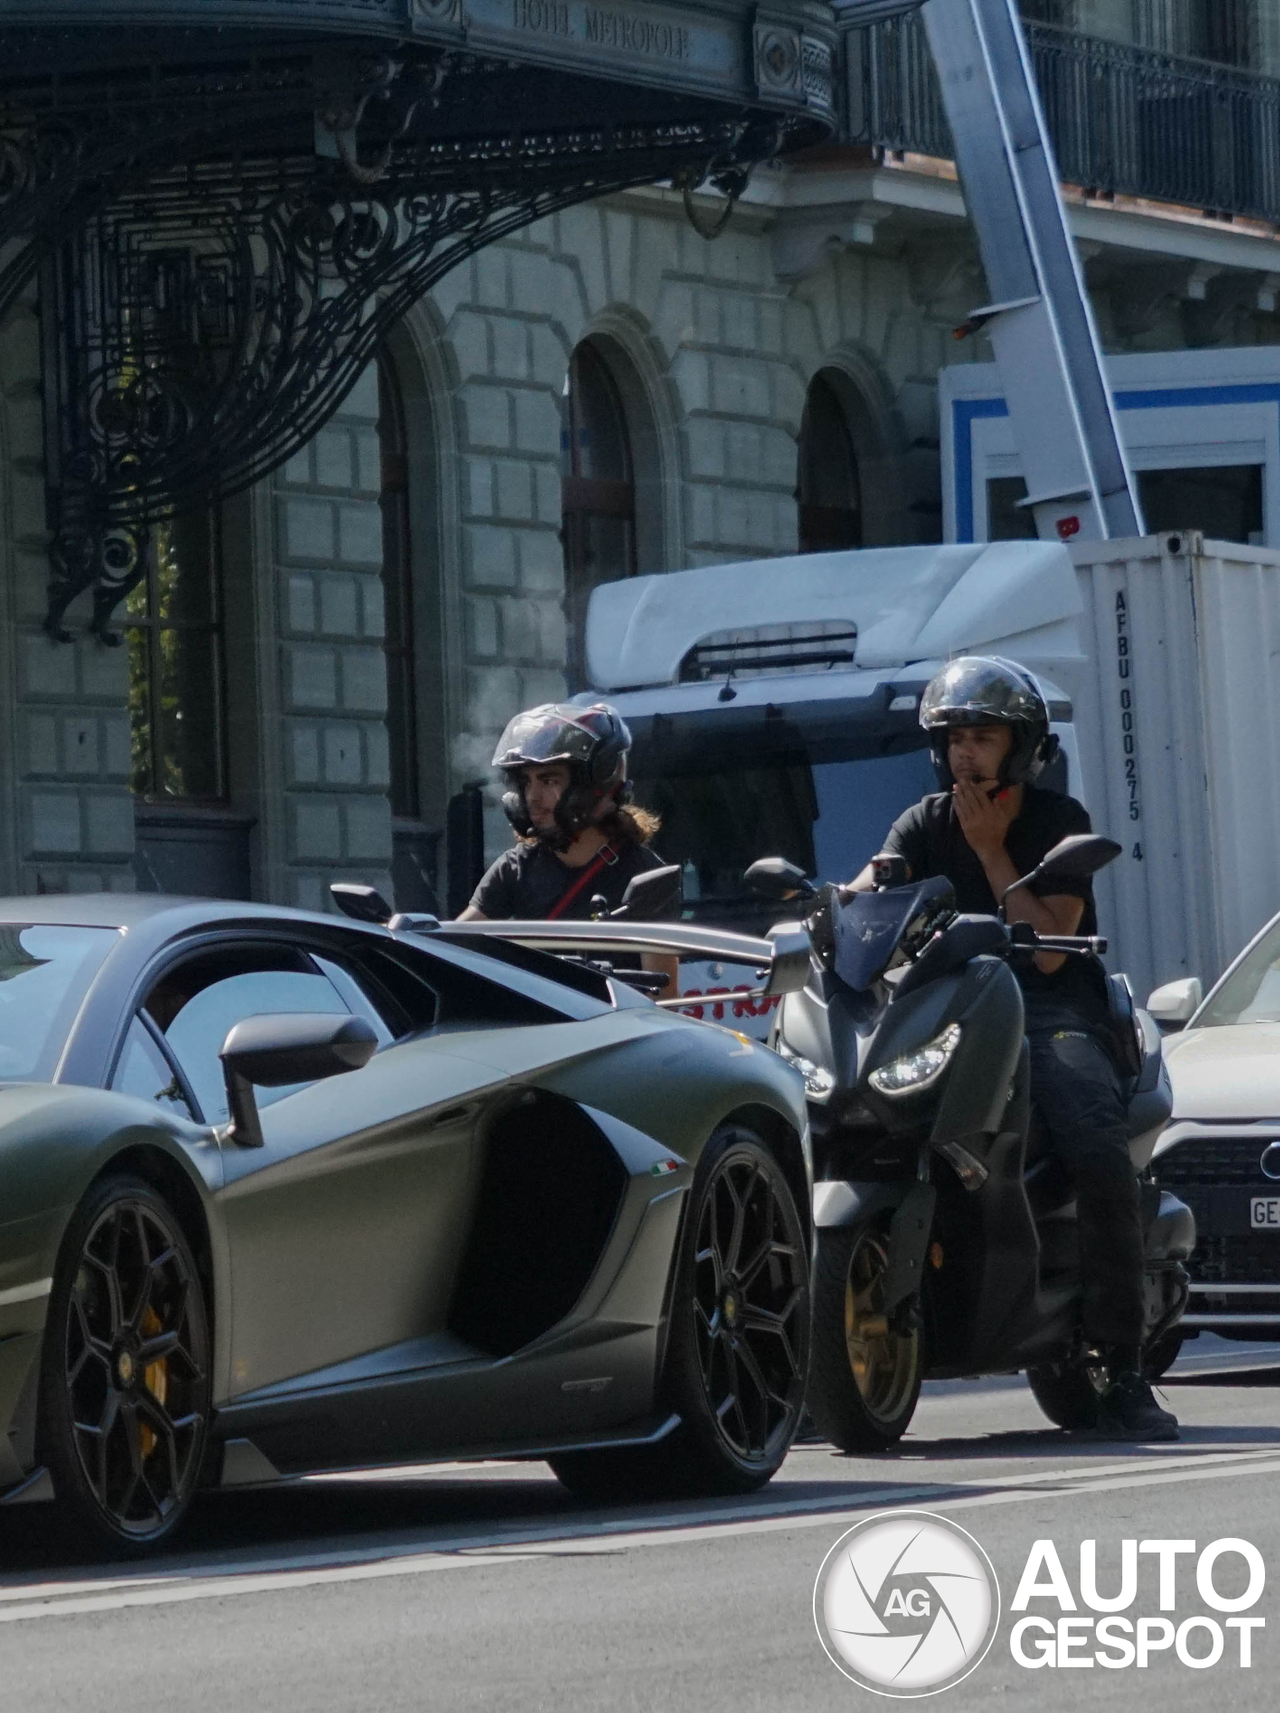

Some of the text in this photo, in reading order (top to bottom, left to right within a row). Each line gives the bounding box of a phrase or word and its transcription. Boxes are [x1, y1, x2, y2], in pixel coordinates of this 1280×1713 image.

[1115, 591, 1142, 862] AFBU 000275 4
[1254, 1201, 1278, 1224] GE
